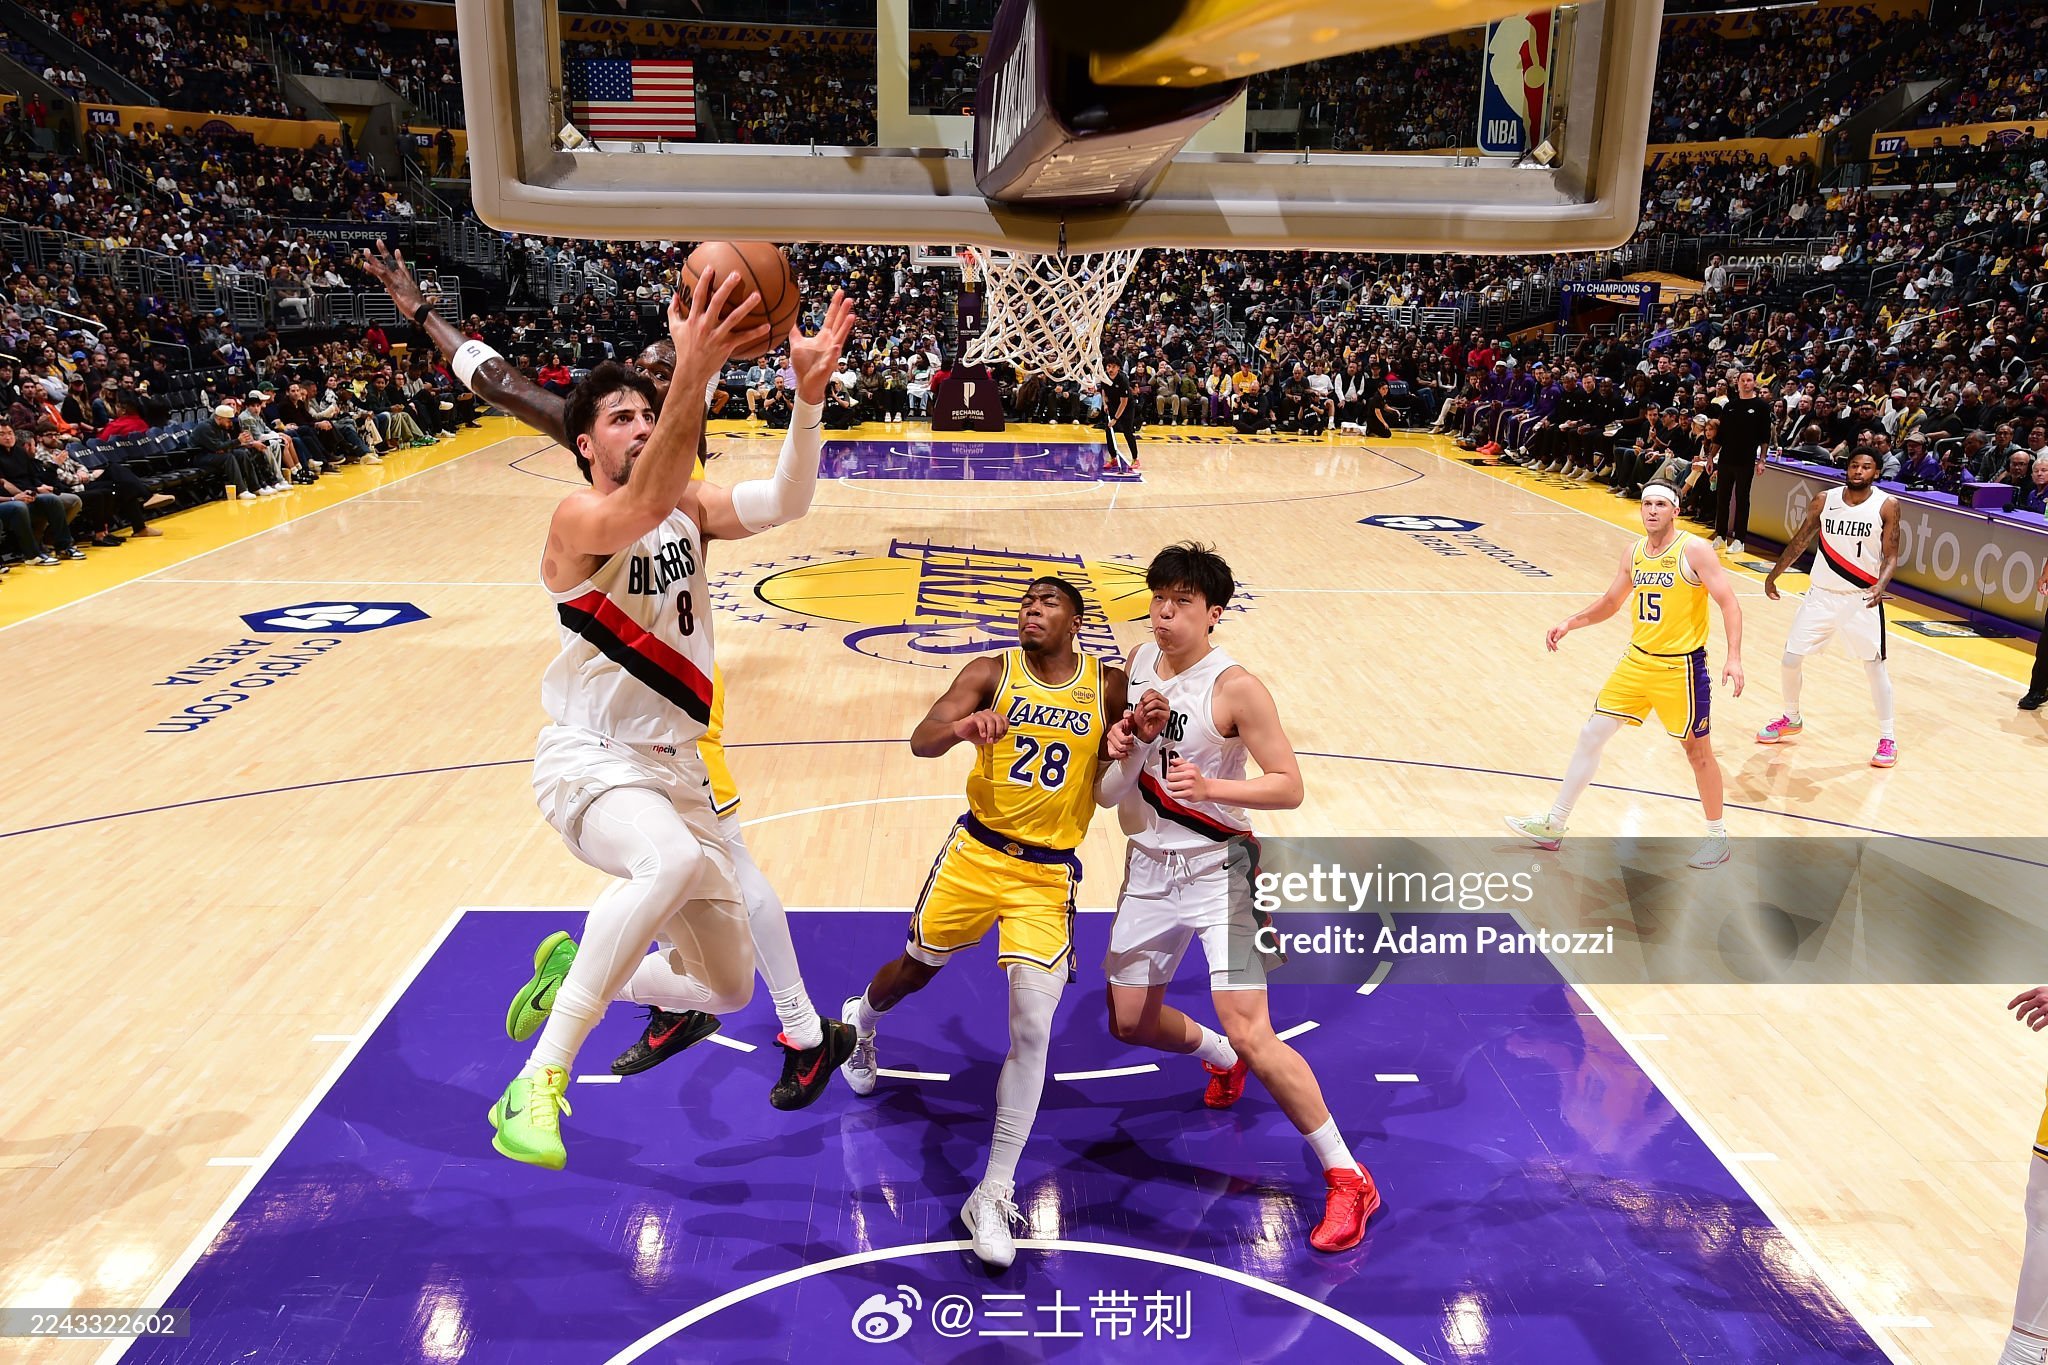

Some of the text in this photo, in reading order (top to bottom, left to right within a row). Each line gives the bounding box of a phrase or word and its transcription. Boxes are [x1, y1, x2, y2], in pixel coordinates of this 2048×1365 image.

[568, 18, 878, 46] LOS ANGELES LAKER
[92, 111, 116, 125] 114
[415, 135, 429, 146] 15
[1486, 119, 1518, 145] NBA
[1880, 138, 1900, 152] 117
[340, 231, 387, 241] EXPRESS
[1572, 283, 1640, 295] 17x CHAMPIONS
[1825, 519, 1872, 537] BLAZERS
[1856, 540, 1862, 558] 1
[1896, 512, 2048, 612] pto.co
[1632, 568, 1675, 588] LAKERS
[676, 590, 695, 636] 8
[1638, 591, 1662, 622] 15
[152, 638, 273, 687] ARENA
[144, 638, 342, 733] crypto.com
[1073, 690, 1095, 700] bibigo
[1006, 695, 1092, 736] LAKERS
[652, 743, 677, 757] ripcity
[1007, 733, 1071, 792] 28
